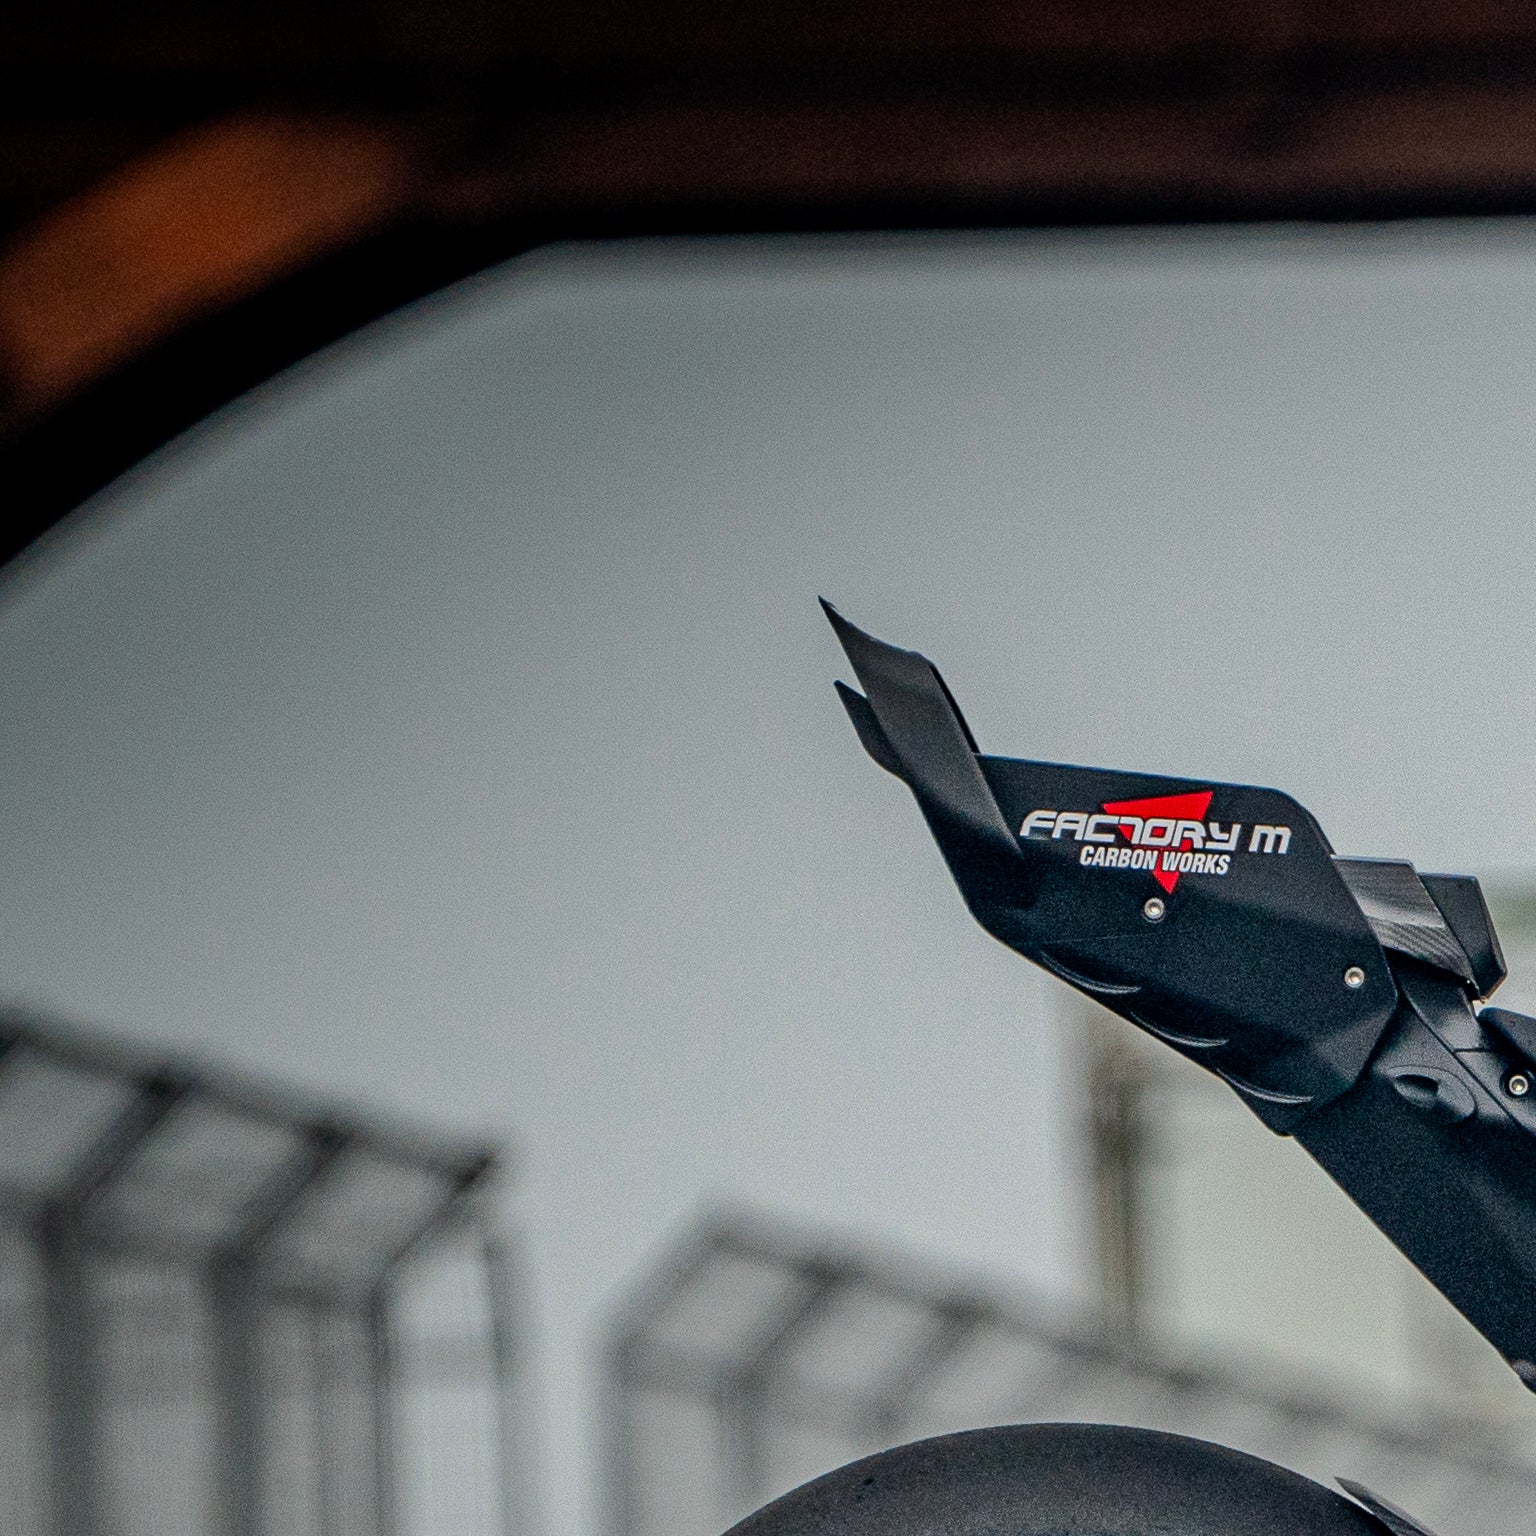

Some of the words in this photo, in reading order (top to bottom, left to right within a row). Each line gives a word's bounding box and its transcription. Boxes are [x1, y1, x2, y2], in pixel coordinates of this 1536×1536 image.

[1019, 811, 1241, 851] FACTORY
[1251, 824, 1292, 855] M
[1080, 846, 1157, 871] CARBON
[1161, 850, 1231, 875] WORKS
